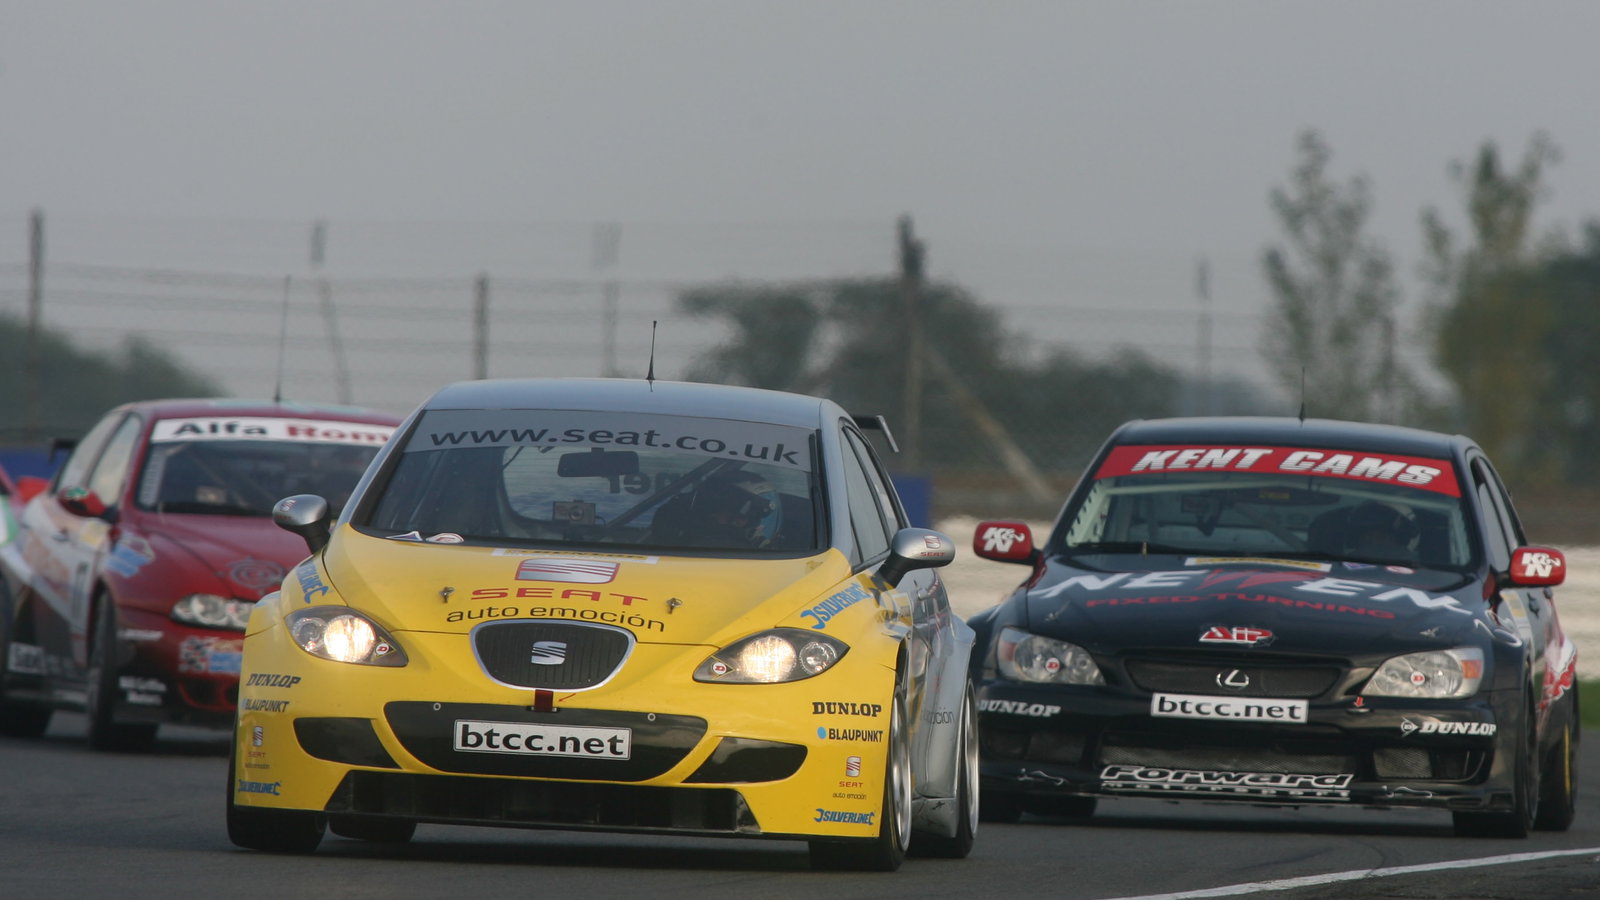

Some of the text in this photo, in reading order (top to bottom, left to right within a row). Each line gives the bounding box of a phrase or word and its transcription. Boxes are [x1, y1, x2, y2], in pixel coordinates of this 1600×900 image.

[173, 421, 268, 436] Alfa
[429, 427, 800, 466] www.seat.co.uk
[1130, 448, 1441, 485] KENT CAMS
[470, 587, 649, 607] SEAT
[446, 606, 665, 633] auto emoción
[246, 673, 302, 688] DUNLOP
[245, 699, 290, 713] BLAUPUNKT
[812, 701, 882, 718] DUNLOP
[1158, 696, 1303, 719] btcc.net
[828, 728, 884, 742] BLAUPUNKT
[1419, 721, 1497, 735] DUNLOP
[461, 724, 624, 756] btcc.net
[1100, 765, 1353, 789] Forward
